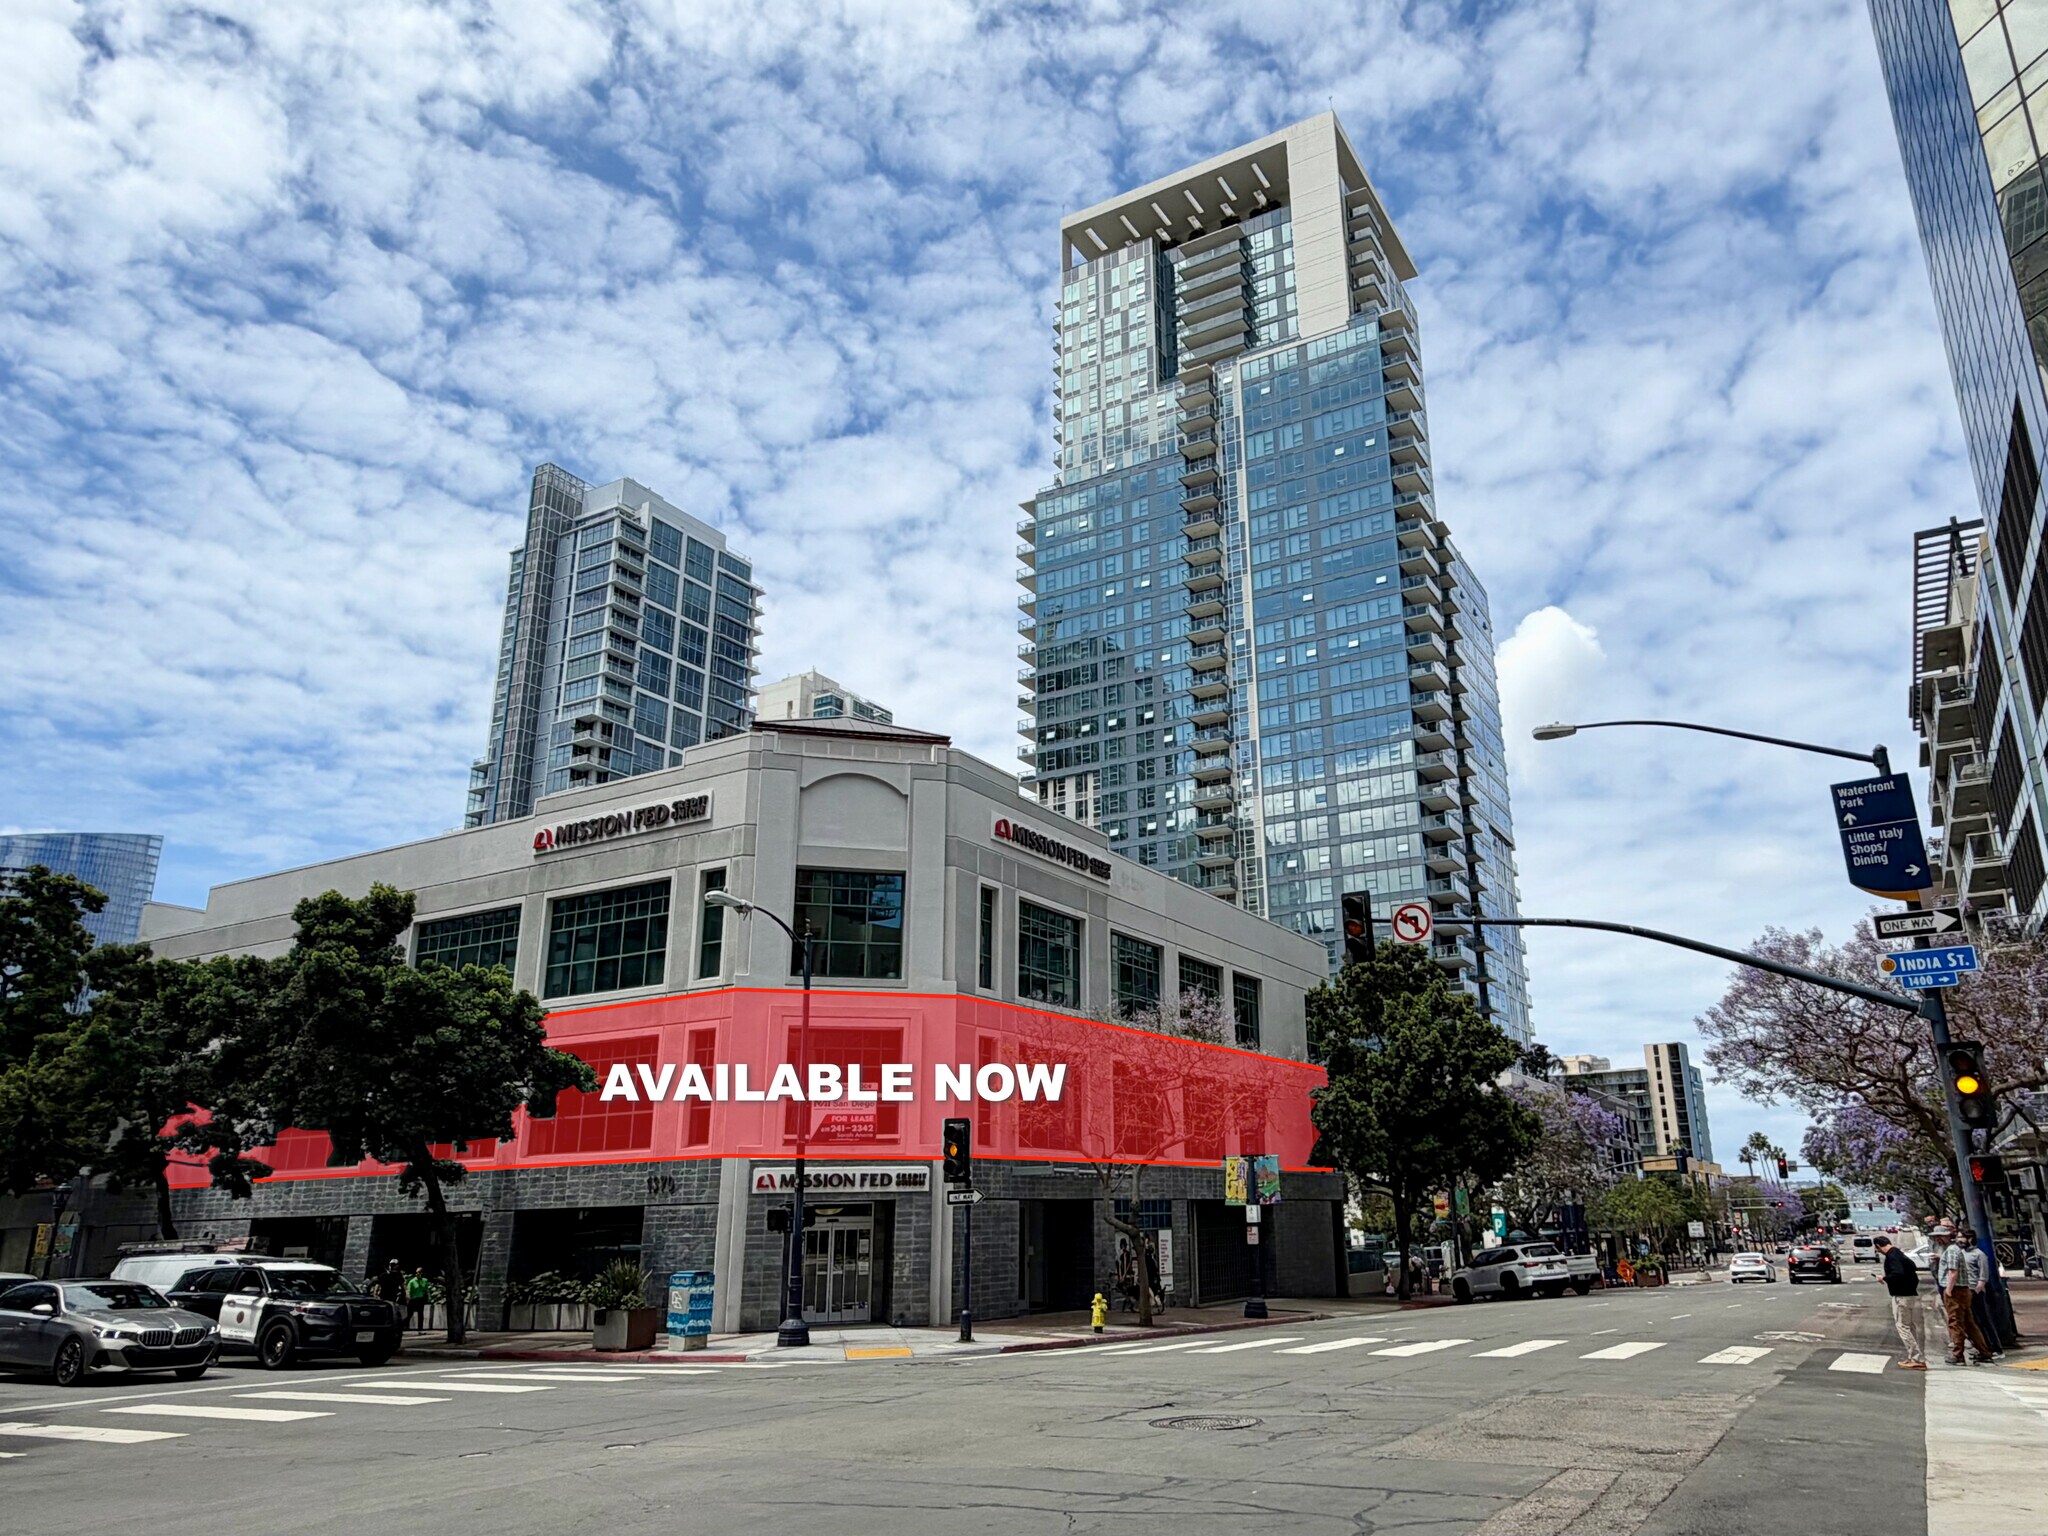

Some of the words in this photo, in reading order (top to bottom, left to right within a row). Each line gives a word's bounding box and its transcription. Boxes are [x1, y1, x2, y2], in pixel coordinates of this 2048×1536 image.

[1837, 780, 1895, 797] Waterfront
[1839, 797, 1864, 809] Park
[555, 811, 632, 845] MISSION
[633, 804, 670, 829] FED
[1848, 831, 1875, 843] Little
[1879, 827, 1903, 839] Italy
[1012, 823, 1067, 863] MISSION
[1067, 846, 1090, 871] FED
[1850, 840, 1887, 855] Shops/
[1852, 854, 1889, 866] Dining
[1883, 920, 1908, 932] ONE
[1911, 917, 1935, 928] WAY
[1899, 956, 1942, 972] INDIA
[1908, 975, 1933, 987] 1400
[830, 1124, 874, 1132] 241-2342
[780, 1173, 856, 1188] MSSION
[859, 1173, 893, 1188] FED
[1494, 1218, 1503, 1233] P
